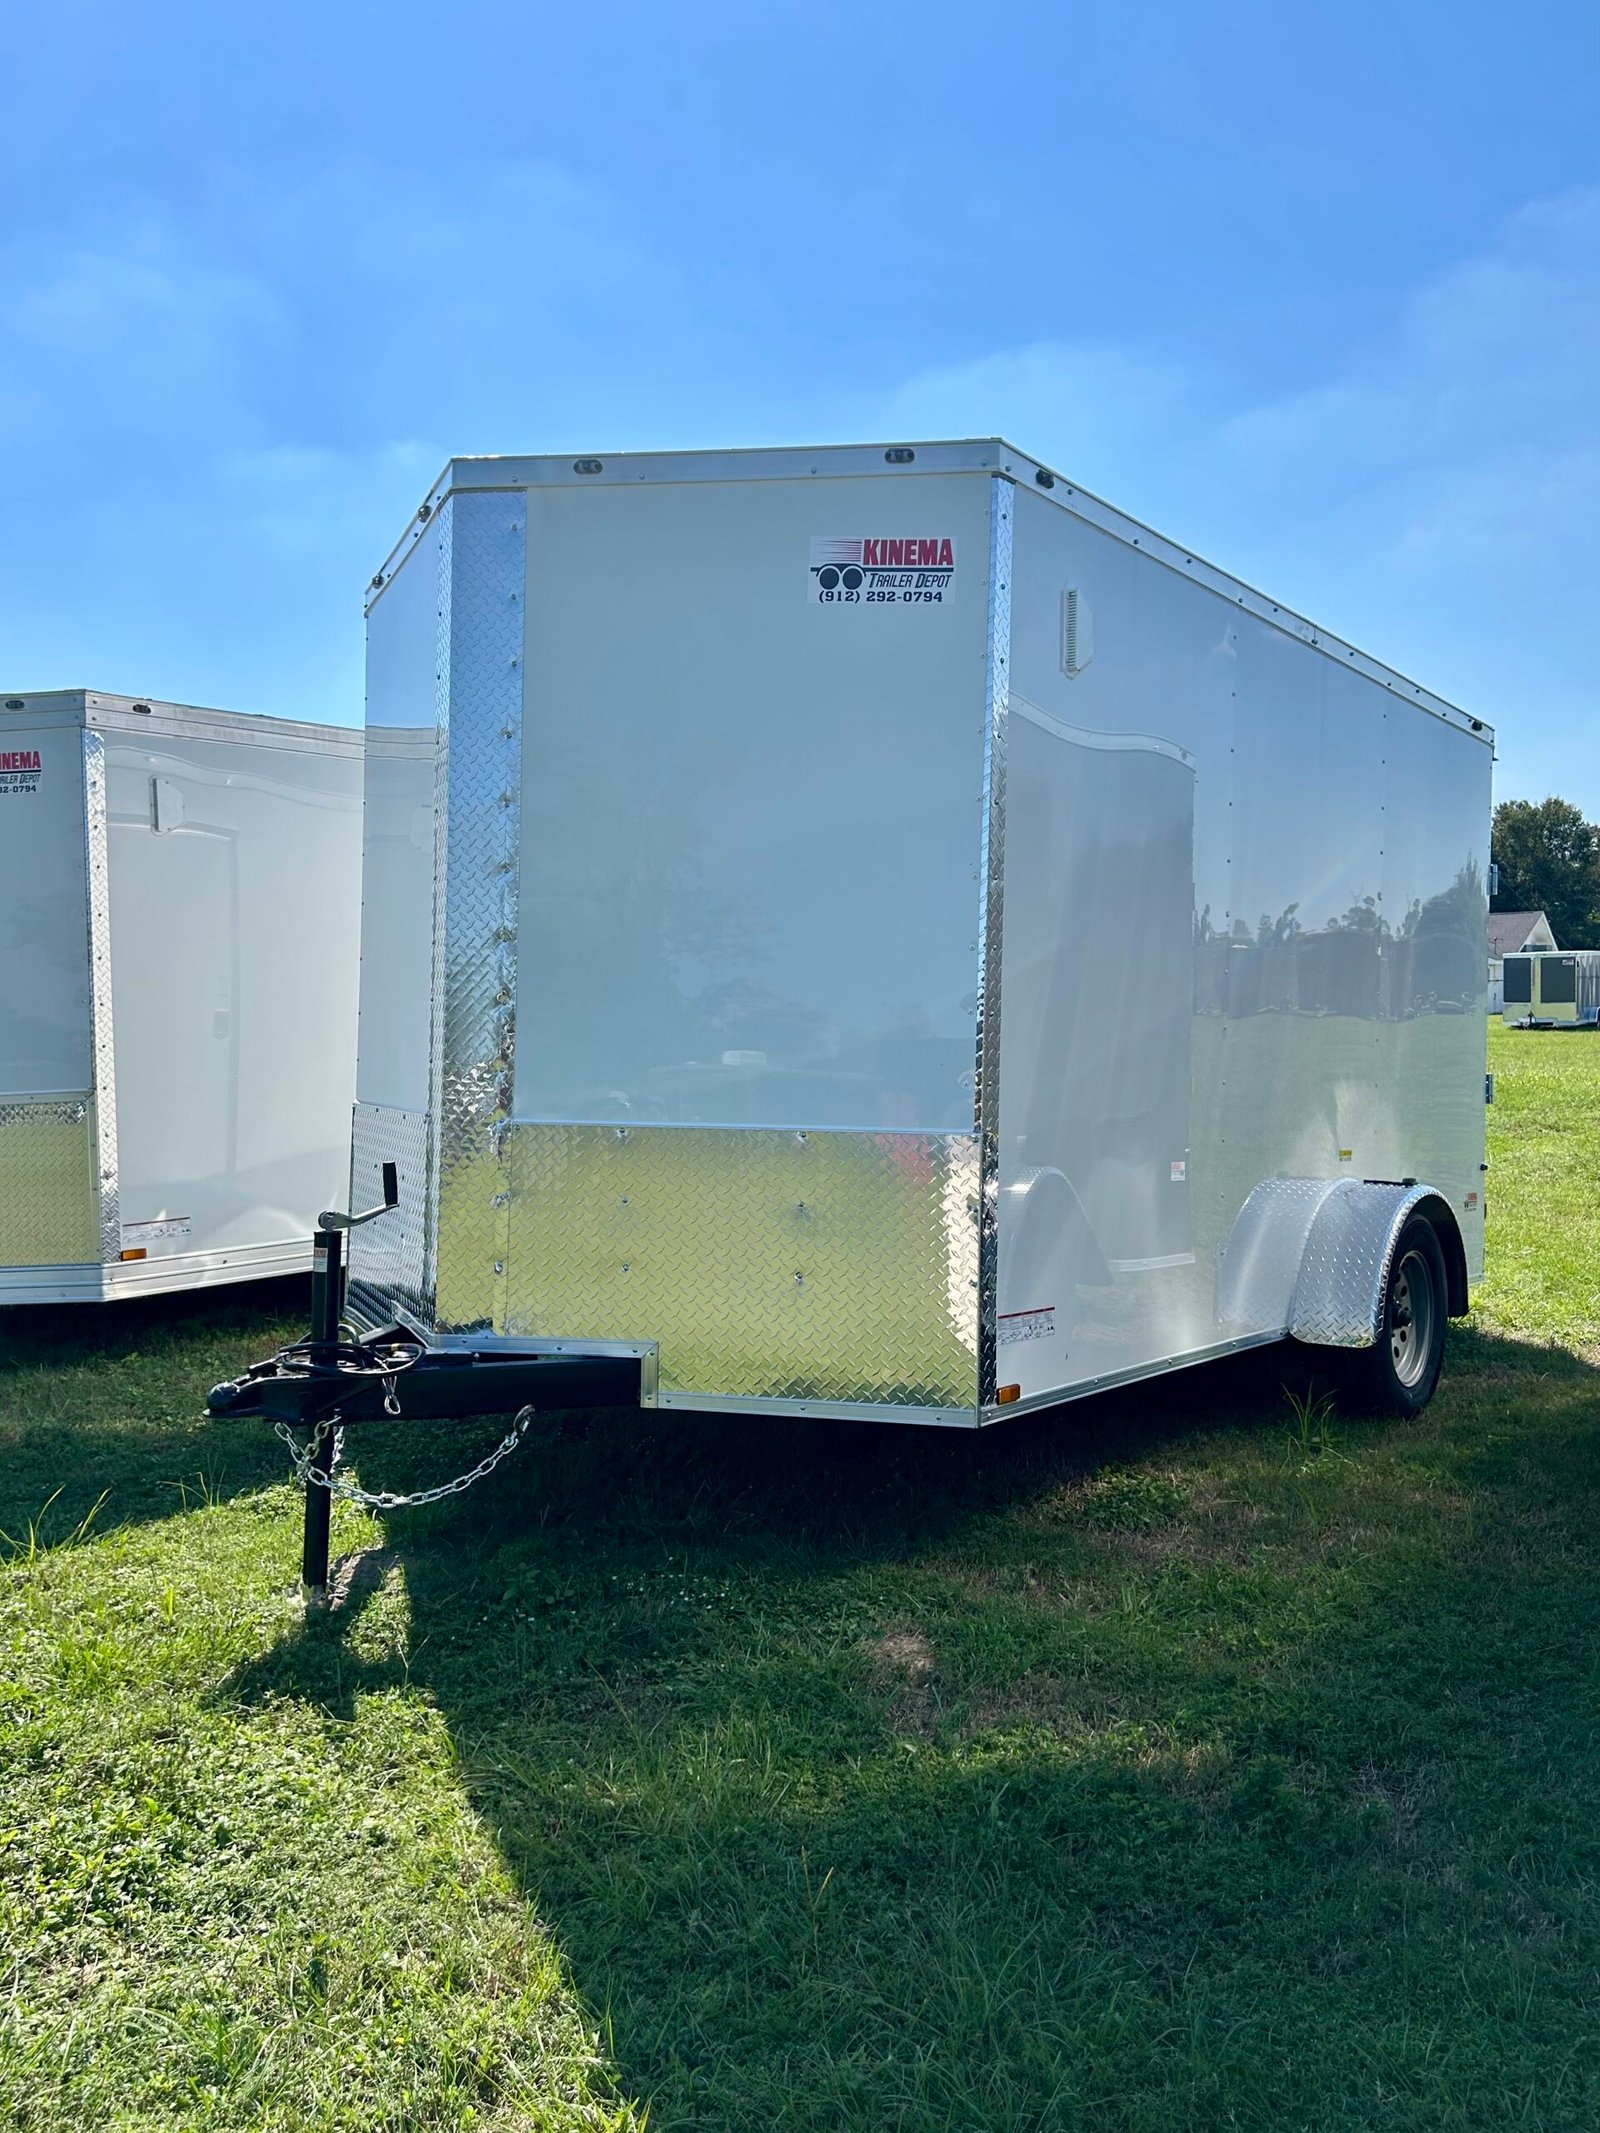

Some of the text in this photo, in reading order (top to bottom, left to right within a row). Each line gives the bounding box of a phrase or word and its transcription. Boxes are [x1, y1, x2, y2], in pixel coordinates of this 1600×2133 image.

[863, 539, 954, 566] KINEMA
[869, 573, 952, 589] TRAILER DEPOT
[819, 590, 943, 604] (912) 292-0794
[19, 773, 41, 784] DEPOT
